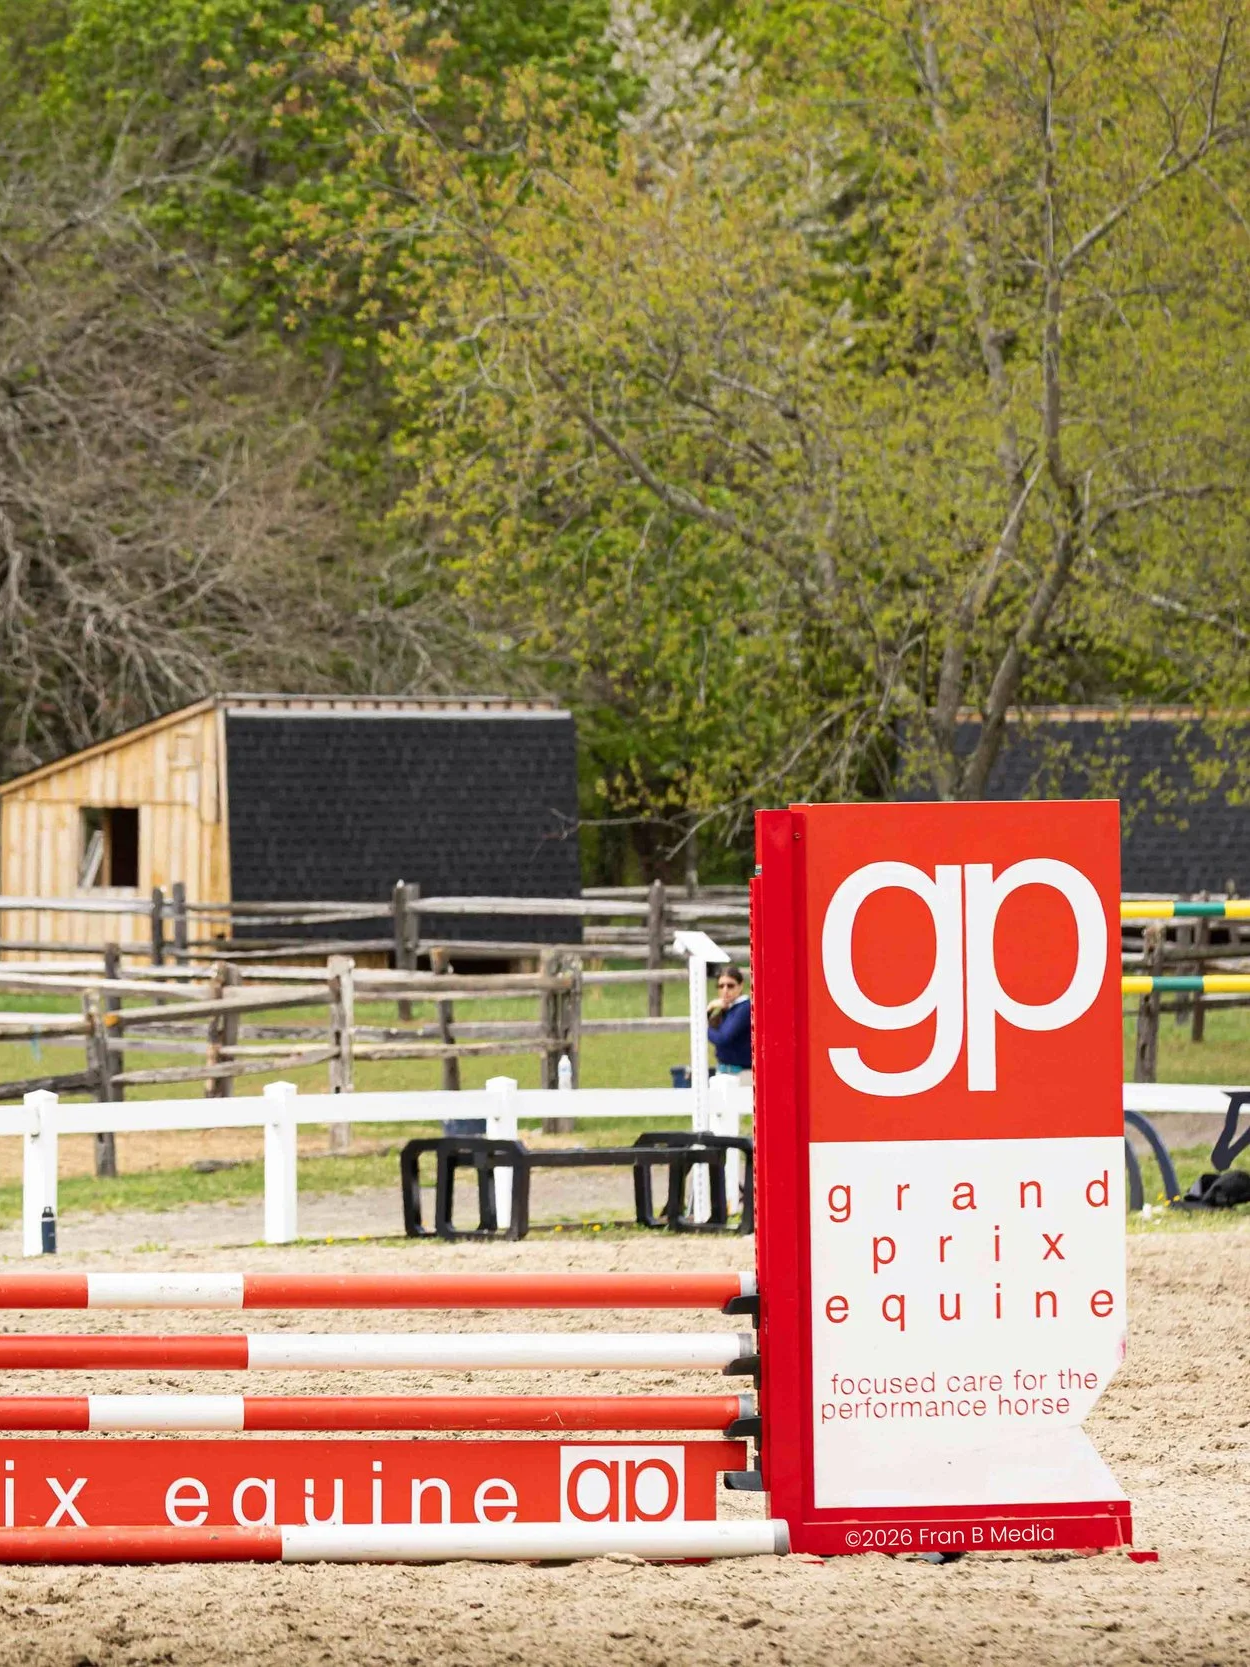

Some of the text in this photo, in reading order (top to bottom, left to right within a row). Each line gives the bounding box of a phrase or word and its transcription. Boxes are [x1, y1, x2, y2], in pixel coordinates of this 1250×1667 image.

[821, 857, 1108, 1097] gp
[827, 1169, 1110, 1223] grand
[872, 1225, 1066, 1273] prix
[825, 1283, 1114, 1331] equine
[831, 1368, 1098, 1396] focused care for the
[821, 1394, 1070, 1424] performance horse
[164, 1461, 519, 1526] equine
